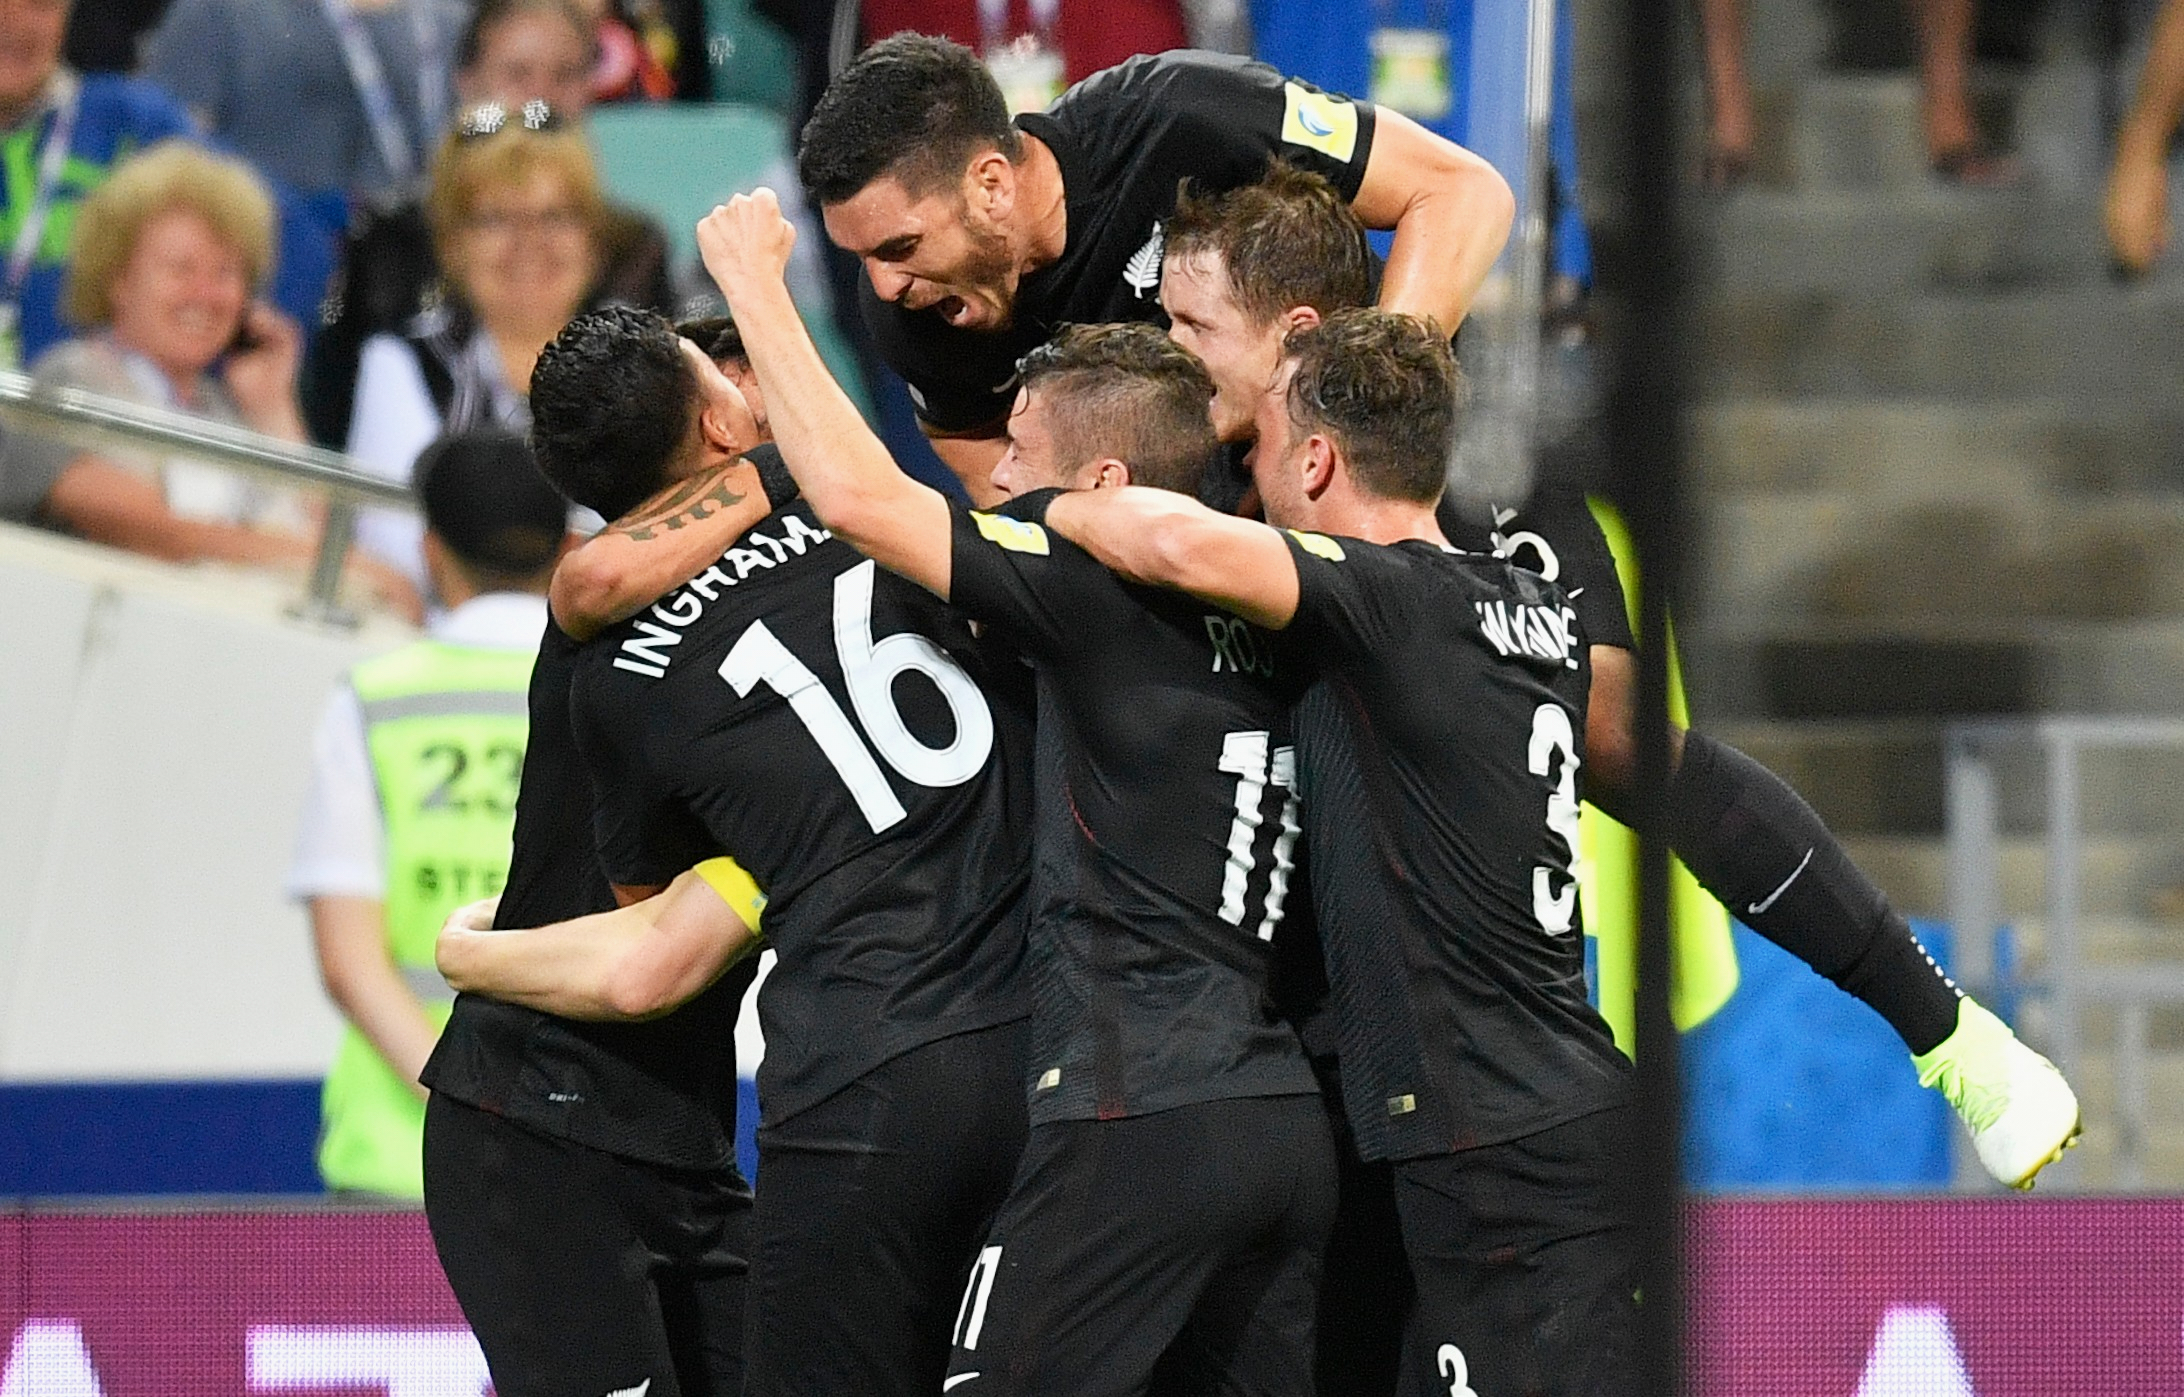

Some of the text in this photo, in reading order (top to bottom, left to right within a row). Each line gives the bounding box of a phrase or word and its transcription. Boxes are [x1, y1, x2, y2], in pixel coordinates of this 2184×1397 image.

[613, 515, 832, 679] INGHAM
[718, 559, 994, 834] 16
[419, 741, 526, 814] 23
[1218, 731, 1302, 942] 11
[1528, 703, 1582, 937] 3
